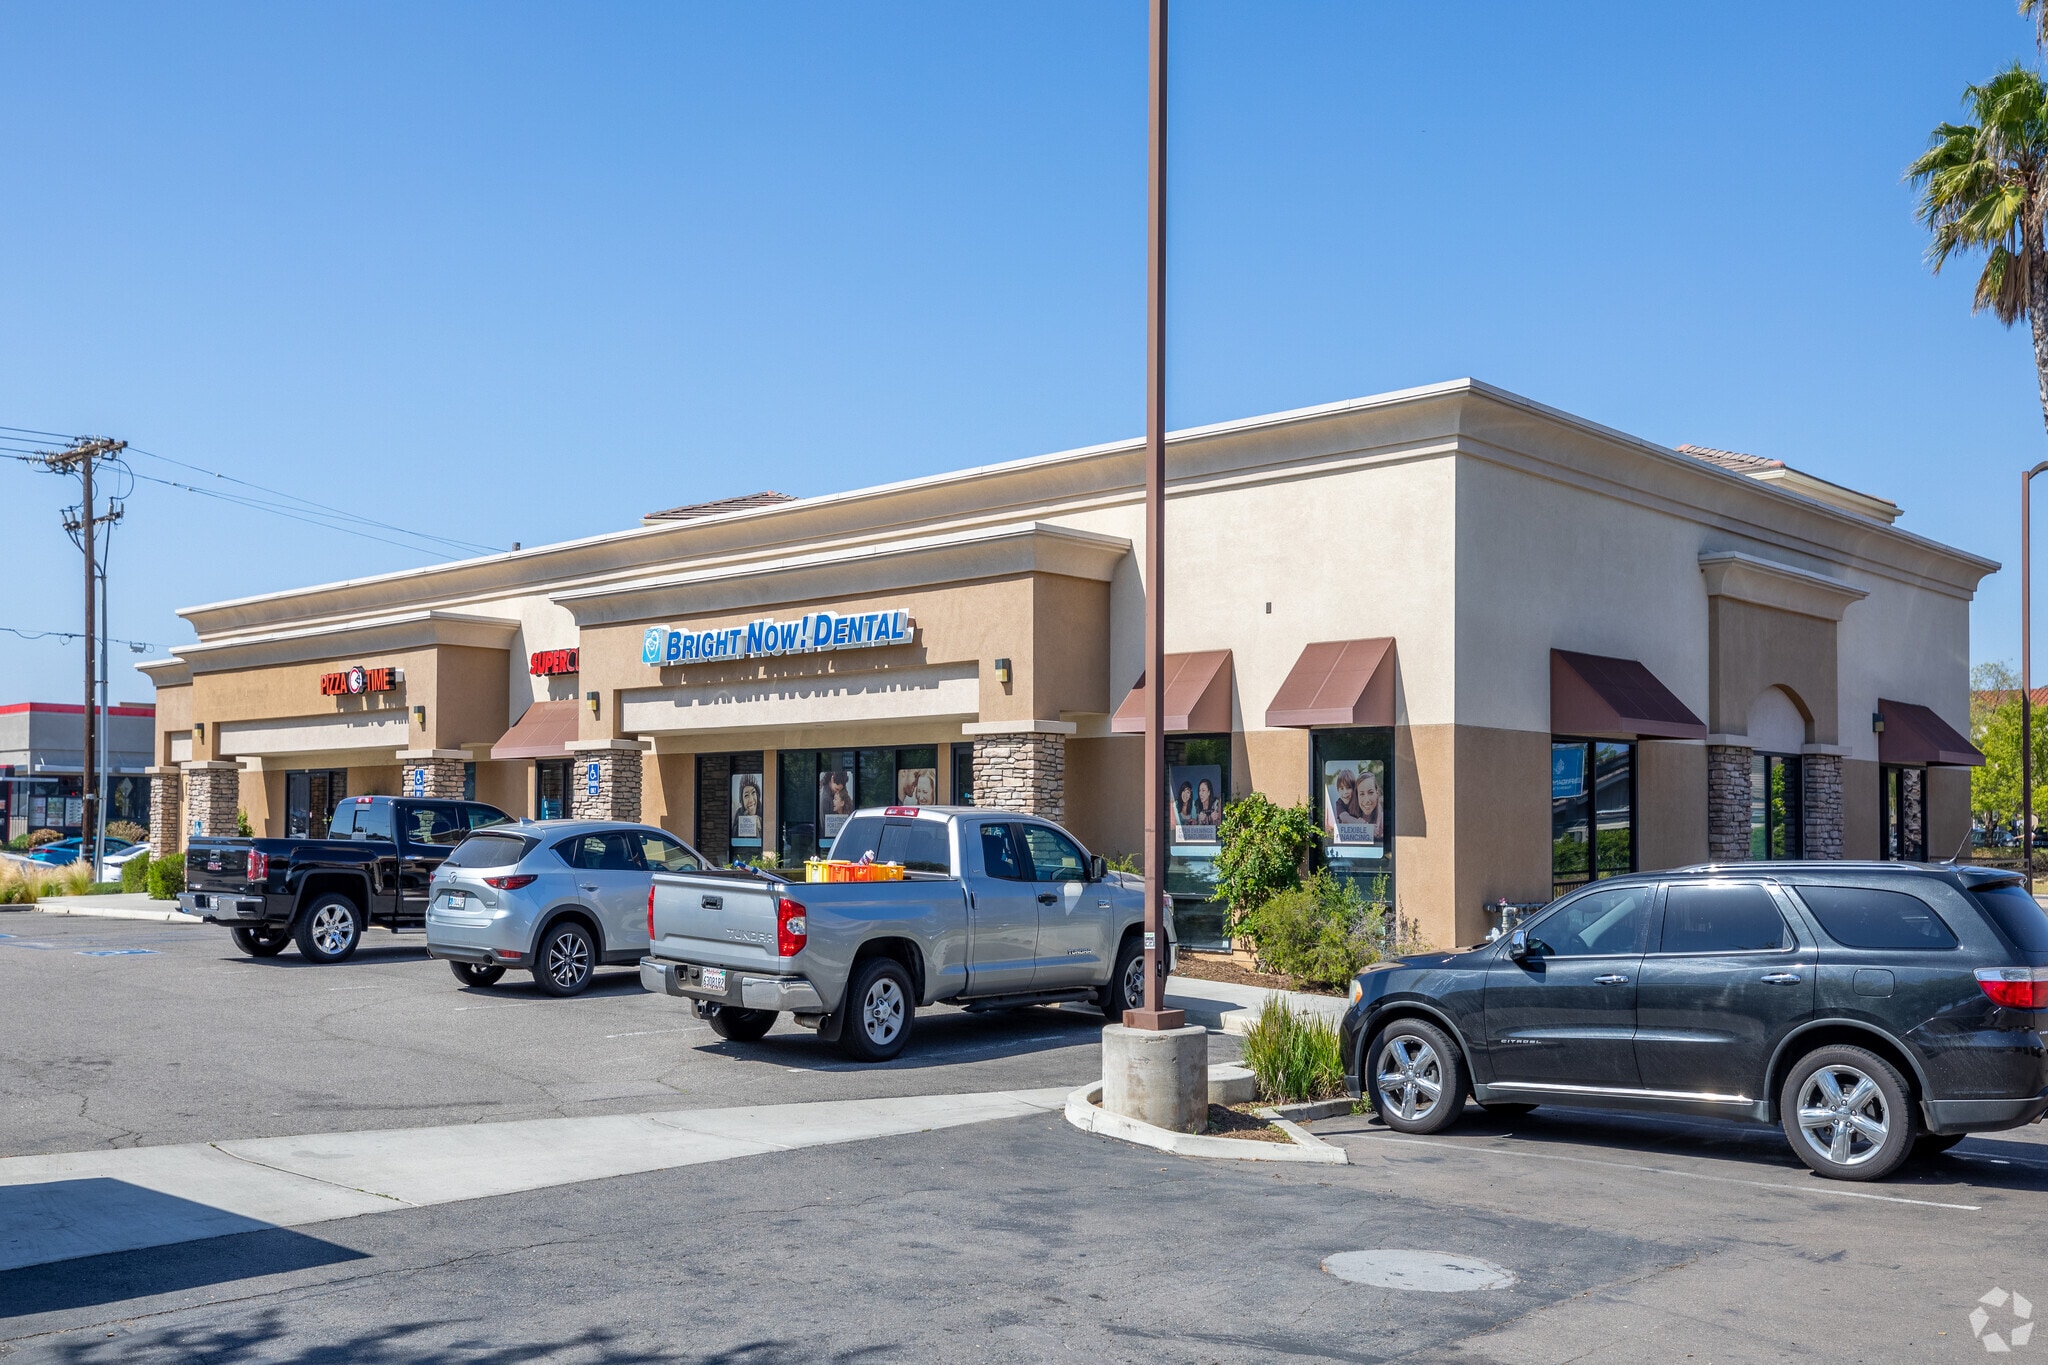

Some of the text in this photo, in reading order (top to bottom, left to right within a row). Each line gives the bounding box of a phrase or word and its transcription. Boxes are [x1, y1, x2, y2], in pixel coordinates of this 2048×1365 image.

[666, 612, 904, 661] BRIGHT NOW! DENTAL
[320, 667, 391, 695] PIZZA TIME
[1340, 826, 1367, 834] FLEXIBLE
[726, 928, 775, 944] TUNDRA
